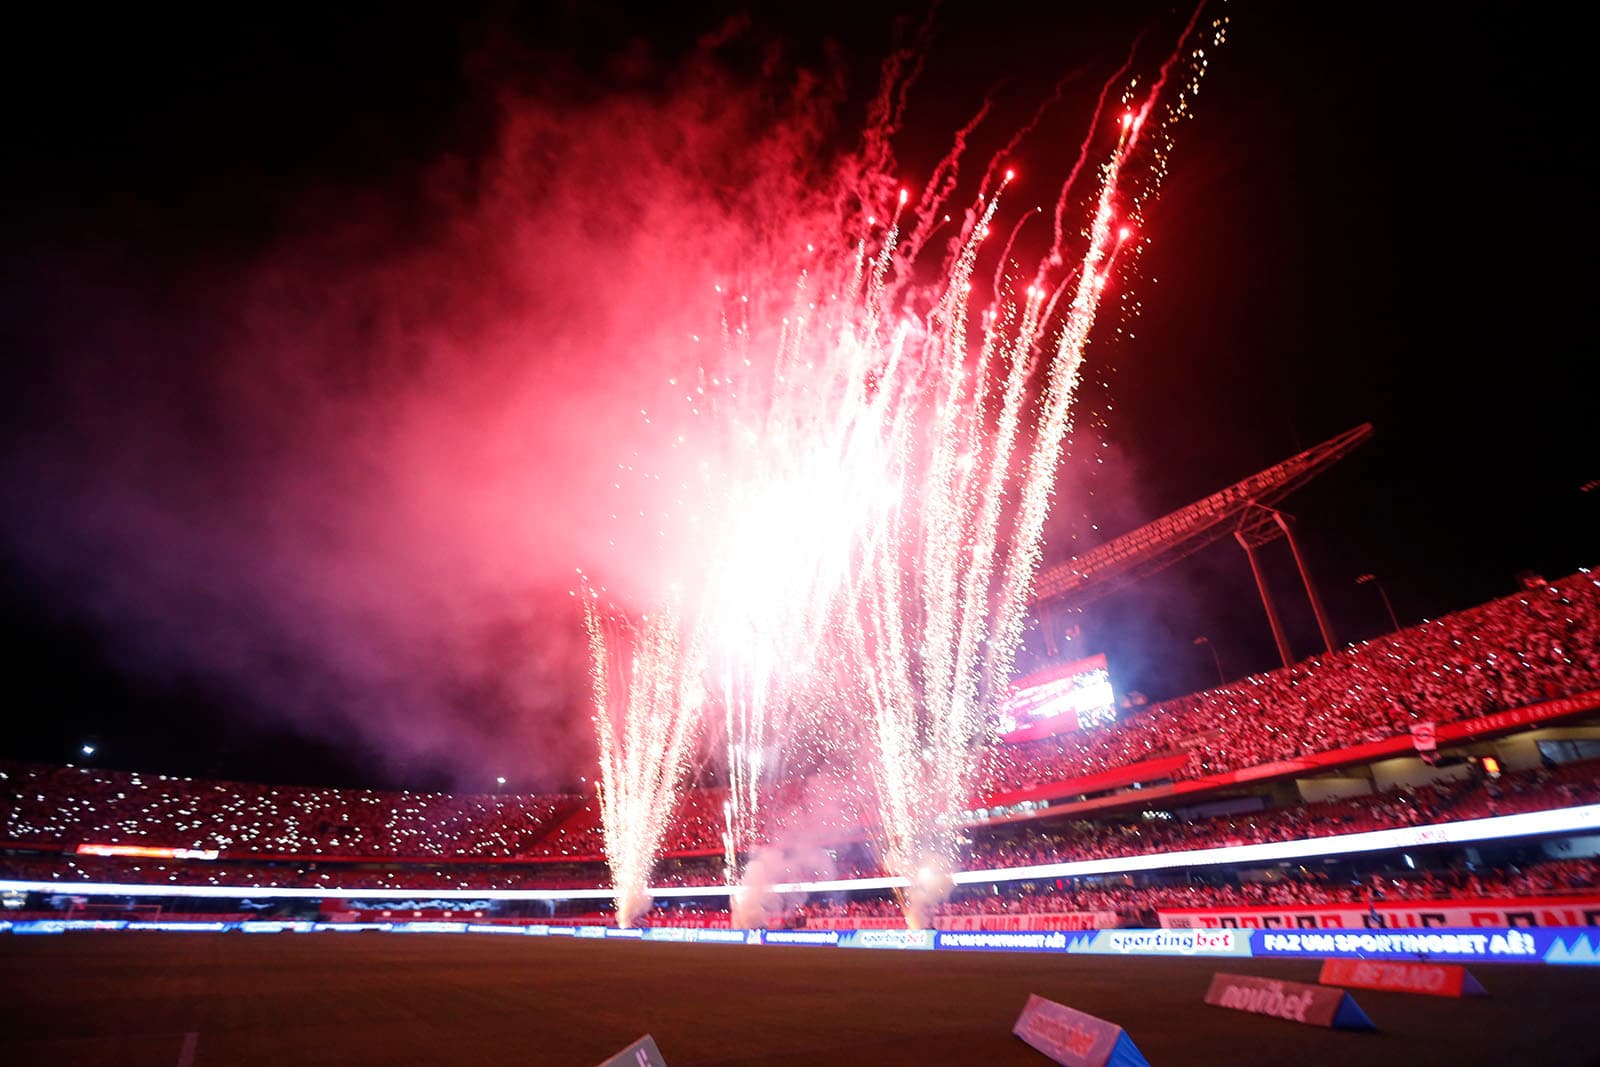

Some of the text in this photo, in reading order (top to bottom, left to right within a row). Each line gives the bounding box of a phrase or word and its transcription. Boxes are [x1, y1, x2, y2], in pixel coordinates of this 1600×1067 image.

[1112, 930, 1233, 951] sportingbet
[1264, 934, 1301, 951] FAZ
[1301, 934, 1334, 952] UM
[1334, 933, 1488, 954] SPORTINGBET
[1350, 962, 1446, 991] BETANO
[1221, 982, 1312, 1021] novibet
